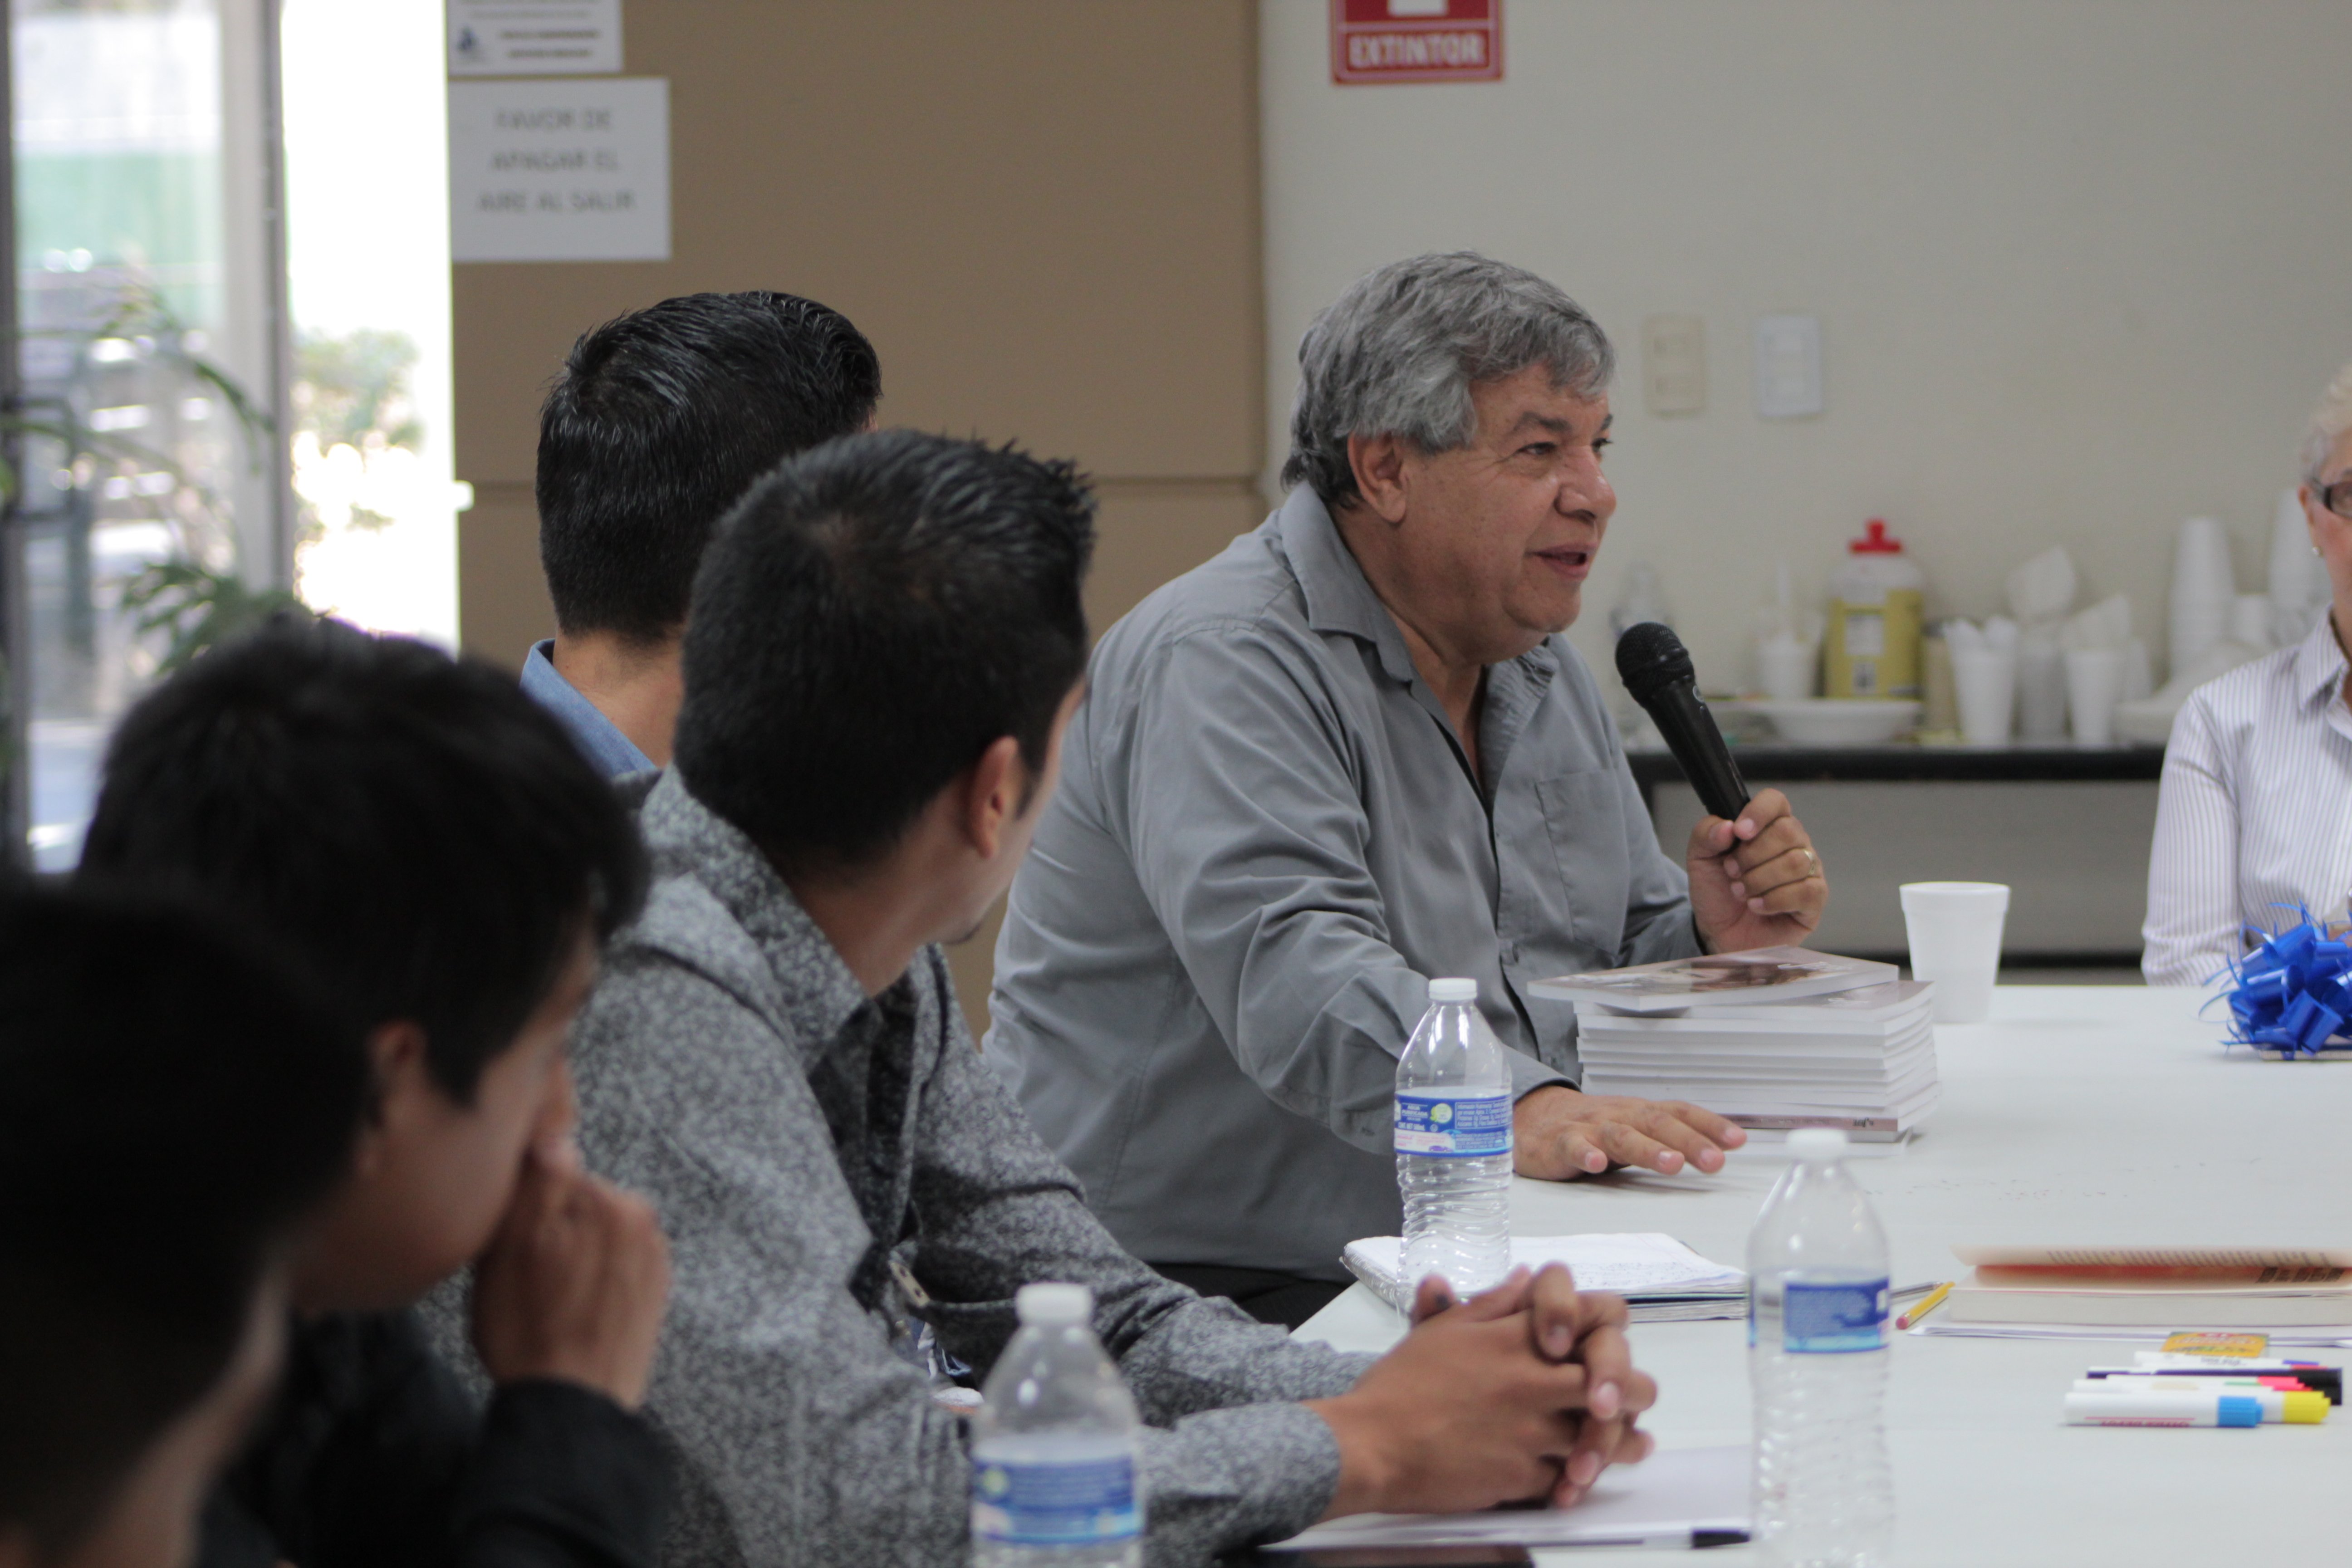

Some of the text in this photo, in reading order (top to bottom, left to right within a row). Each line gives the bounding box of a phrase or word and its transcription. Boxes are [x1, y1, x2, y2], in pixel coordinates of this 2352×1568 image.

[1349, 33, 1483, 68] EXTINTOR
[495, 107, 612, 129] FAVOR DE
[491, 150, 587, 171] APAGAR
[478, 191, 526, 211] AIRE
[570, 189, 636, 212] SALIR
